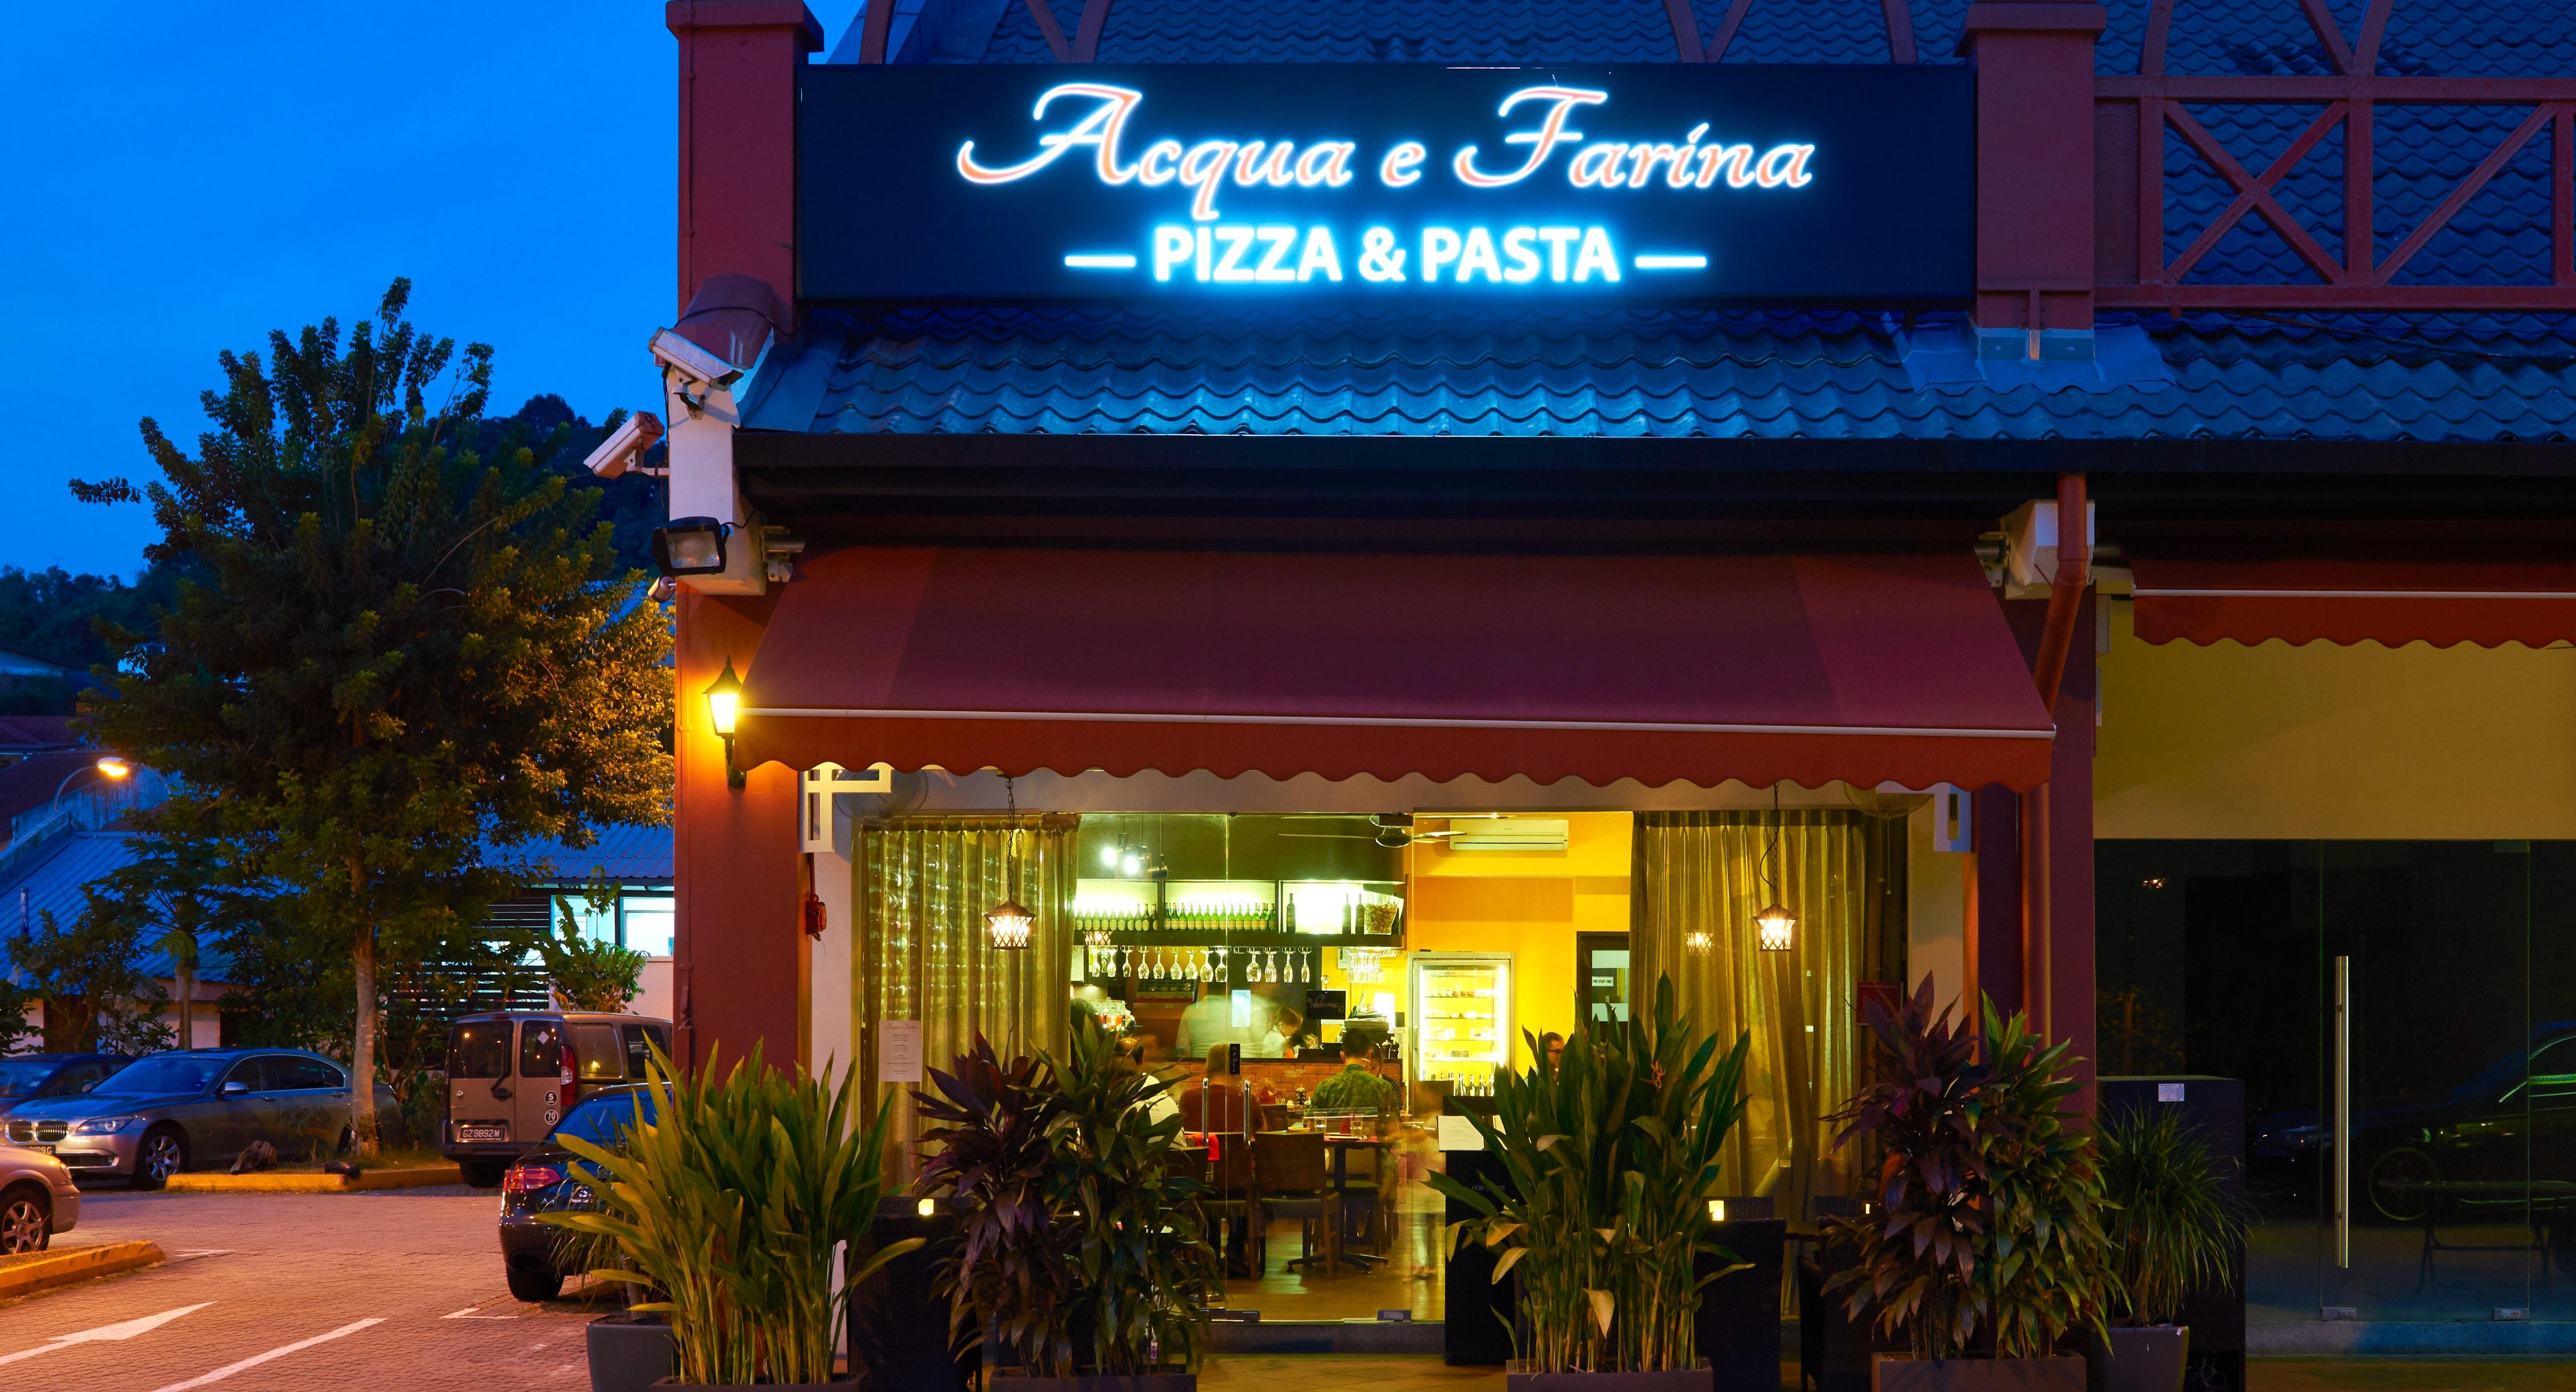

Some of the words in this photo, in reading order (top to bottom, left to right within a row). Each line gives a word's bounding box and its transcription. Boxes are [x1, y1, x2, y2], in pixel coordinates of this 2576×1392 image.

[955, 81, 1356, 223] Acqua
[1379, 141, 1427, 189] e
[1452, 84, 1816, 189] Farina
[1153, 224, 1343, 283] PIZZA
[1357, 226, 1407, 283] &
[1421, 226, 1622, 283] PASTA
[1308, 994, 1345, 1013] Welcome
[547, 1112, 556, 1120] 70
